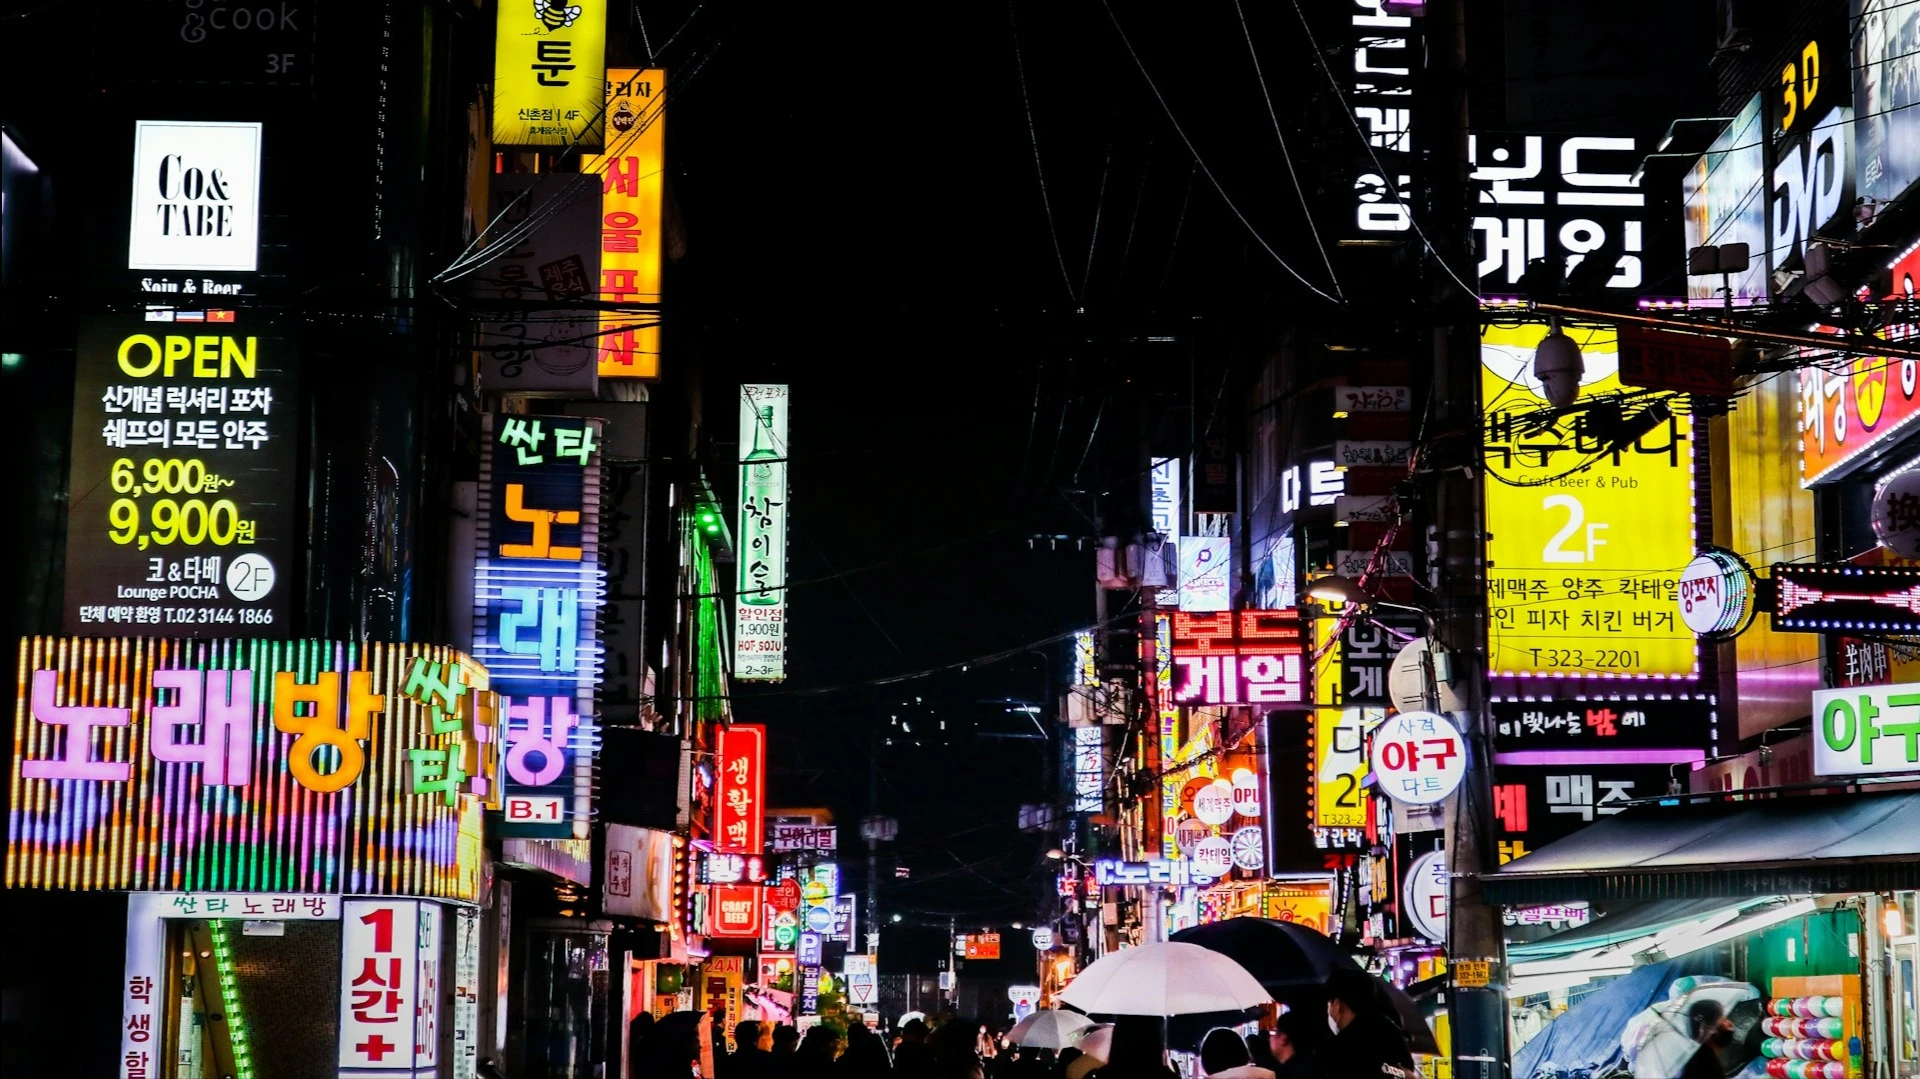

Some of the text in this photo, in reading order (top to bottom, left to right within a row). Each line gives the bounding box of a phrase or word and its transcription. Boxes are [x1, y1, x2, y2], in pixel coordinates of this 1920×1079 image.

[263, 52, 296, 75] 3F
[531, 40, 576, 87] 툰
[1782, 41, 1820, 132] 3D
[518, 108, 580, 121] 신촌점 4F
[158, 154, 231, 201] Co&
[1468, 135, 1645, 206] 보드
[1773, 106, 1845, 270] DVD
[157, 204, 234, 237] TABE
[1472, 216, 1642, 288] 게임
[117, 334, 257, 378] OPEN
[102, 385, 273, 415] 신개념 럭셔리 포차
[102, 418, 269, 450] 쉐프의 모든 안주
[499, 418, 597, 466] 싼타
[1282, 460, 1345, 513] 다트
[1518, 475, 1639, 489] Craft Beer & Pub
[108, 498, 256, 551] 9,900원
[1543, 494, 1610, 564] 2F
[745, 496, 783, 597] 참이슬
[117, 585, 219, 601] Lounge POCHA
[234, 562, 270, 592] 2F
[1562, 577, 1605, 600] 양주
[1619, 578, 1681, 601] 칵테일
[79, 606, 273, 624] 단체 예약 환영 T.02 3144 1866
[738, 623, 780, 636] 1,900원
[1527, 609, 1570, 631] 피자
[1581, 610, 1622, 632] 치킨
[1633, 610, 1674, 632] 버거
[1173, 612, 1302, 655] 보드
[1547, 649, 1640, 668] 323-2201
[1845, 642, 1887, 687] 羊肉串
[1174, 656, 1302, 703] 게임
[20, 667, 386, 794] 노래방
[400, 655, 467, 807] 싼타
[1397, 718, 1436, 736] 사격
[1823, 693, 1920, 765] 야구
[1382, 738, 1457, 772] 야구
[1402, 776, 1443, 793] 다트
[1545, 775, 1635, 822] 맥주
[509, 800, 559, 820] B.1
[726, 756, 752, 848] 생활맥
[1199, 847, 1232, 865] 칵테일
[173, 896, 328, 917] 싼타 노래방
[721, 901, 753, 912] CRAFT
[773, 896, 798, 909] 노래방
[775, 886, 795, 898] 코인
[724, 912, 749, 924] BEER
[801, 934, 818, 956] P
[704, 959, 739, 973] 24시
